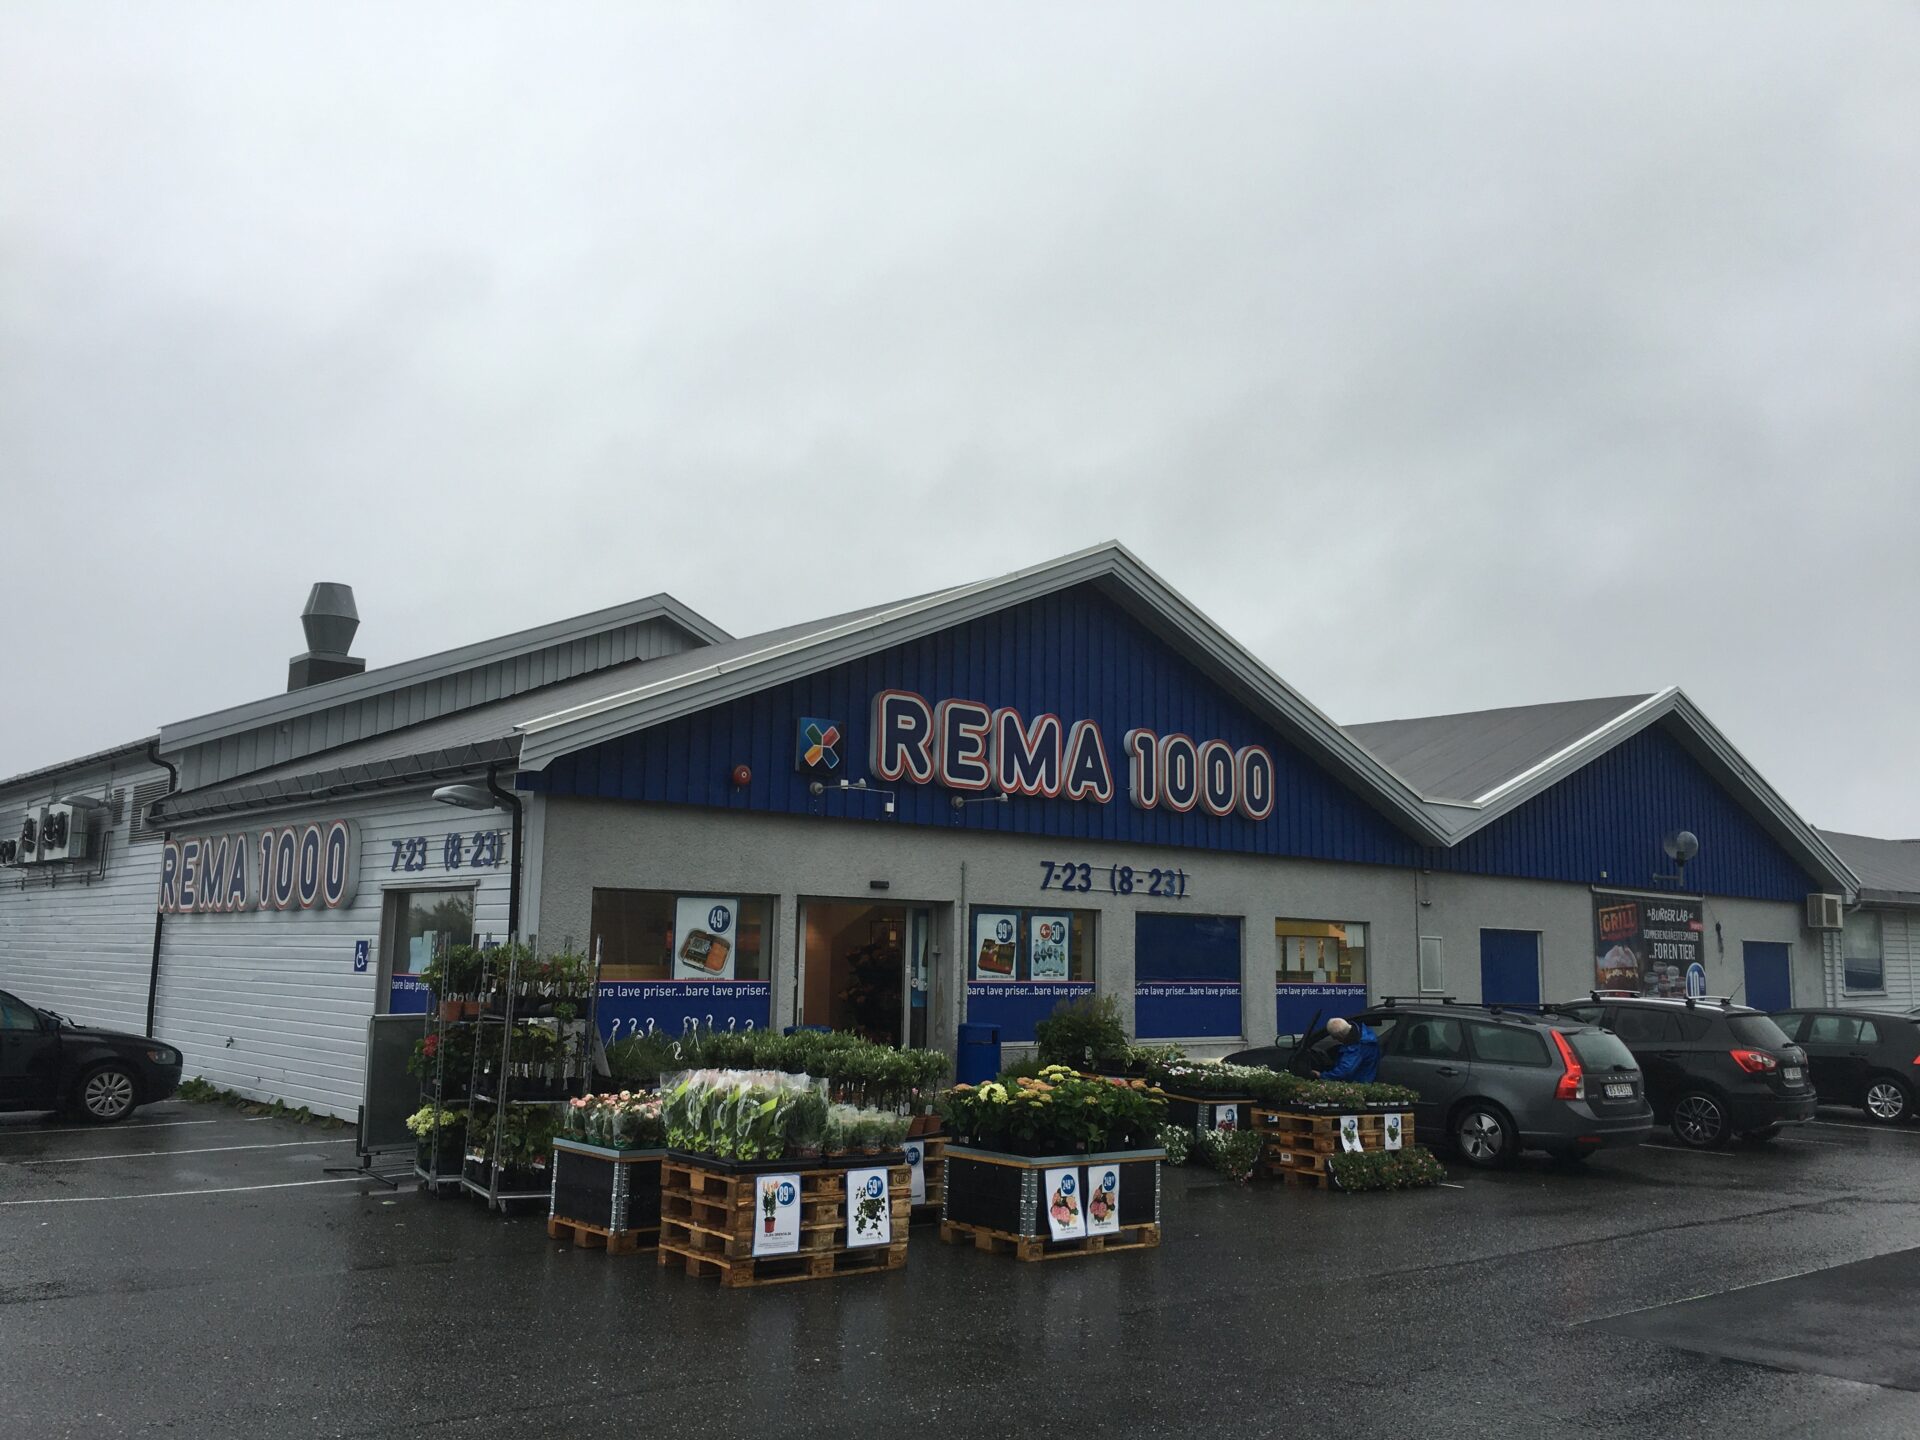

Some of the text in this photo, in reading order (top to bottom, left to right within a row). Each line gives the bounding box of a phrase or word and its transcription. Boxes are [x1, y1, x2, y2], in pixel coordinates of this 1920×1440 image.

[873, 689, 1274, 820] REMA 1000
[391, 836, 427, 872] 7-23
[158, 819, 350, 913] REMA 1000
[1040, 861, 1092, 892] 7-23
[1602, 910, 1635, 933] GRILL
[1651, 908, 1688, 923] BURGER LAB
[403, 979, 415, 991] lave
[617, 985, 641, 998] lave
[712, 984, 733, 997] lave
[986, 985, 1003, 996] lave
[1053, 985, 1069, 996] lave
[1150, 986, 1164, 996] lave
[1205, 986, 1218, 996] lave
[1288, 986, 1301, 996] lave
[1335, 986, 1347, 996] lave
